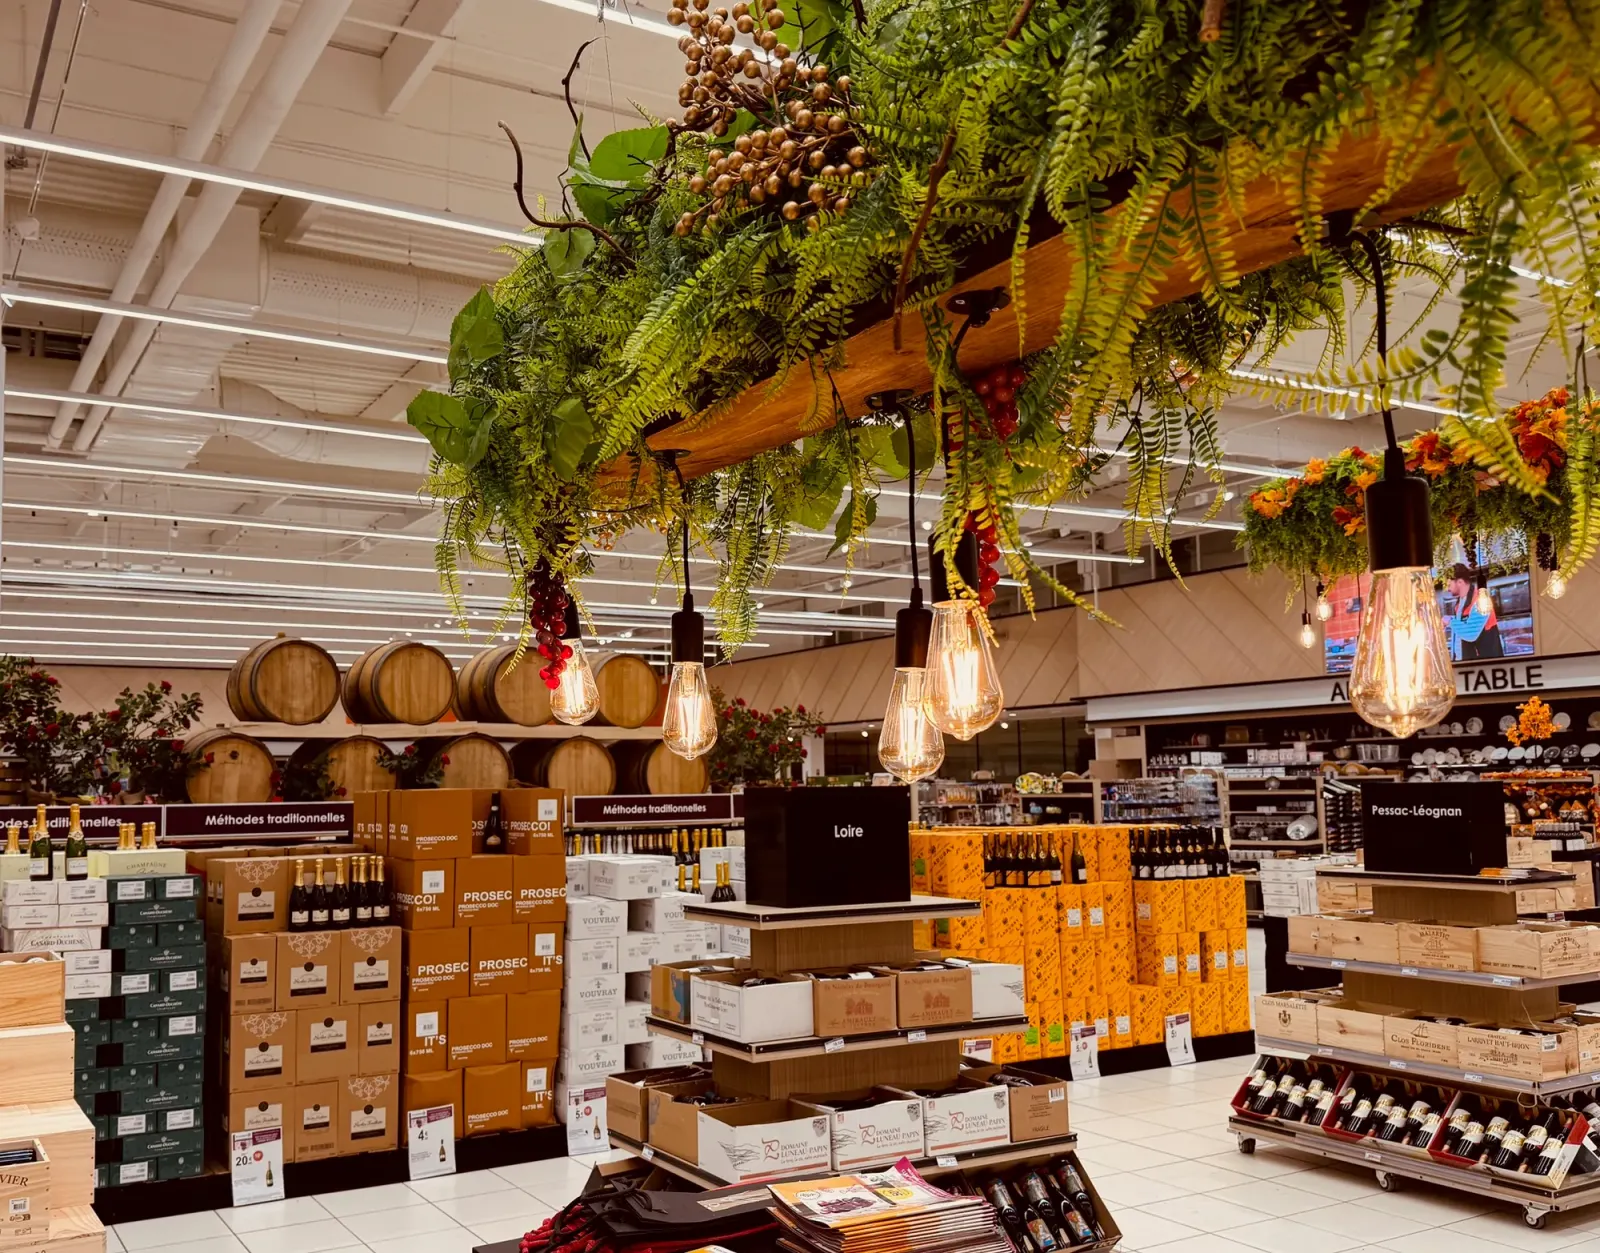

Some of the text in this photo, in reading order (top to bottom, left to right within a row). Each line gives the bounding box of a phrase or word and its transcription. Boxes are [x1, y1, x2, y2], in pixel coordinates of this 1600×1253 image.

[1458, 664, 1544, 692] TABLE
[603, 803, 707, 815] Méthodes traditionnelles
[1372, 804, 1462, 819] Pessac-Léognan
[205, 812, 345, 825] Méthodes traditionnelles
[834, 824, 864, 838] Loire
[463, 890, 513, 902] PROSEC
[520, 887, 566, 899] PROSEC
[583, 916, 620, 925] VOUVRAY
[479, 957, 528, 970] PROSEC
[542, 955, 563, 966] IT'S
[417, 962, 469, 976] PROSEC
[580, 988, 618, 998] VOUVRAY
[424, 1034, 447, 1047] IT'S
[662, 1051, 696, 1061] VOUVRAY
[579, 1060, 617, 1071] VOUVRAY
[965, 1113, 988, 1121] DOMAINE
[875, 1127, 901, 1136] DOMAINE
[876, 1130, 920, 1143] LUNEAU PAPIN
[780, 1141, 809, 1150] DOMAINE
[781, 1145, 828, 1157] LUNEAU PAPIN
